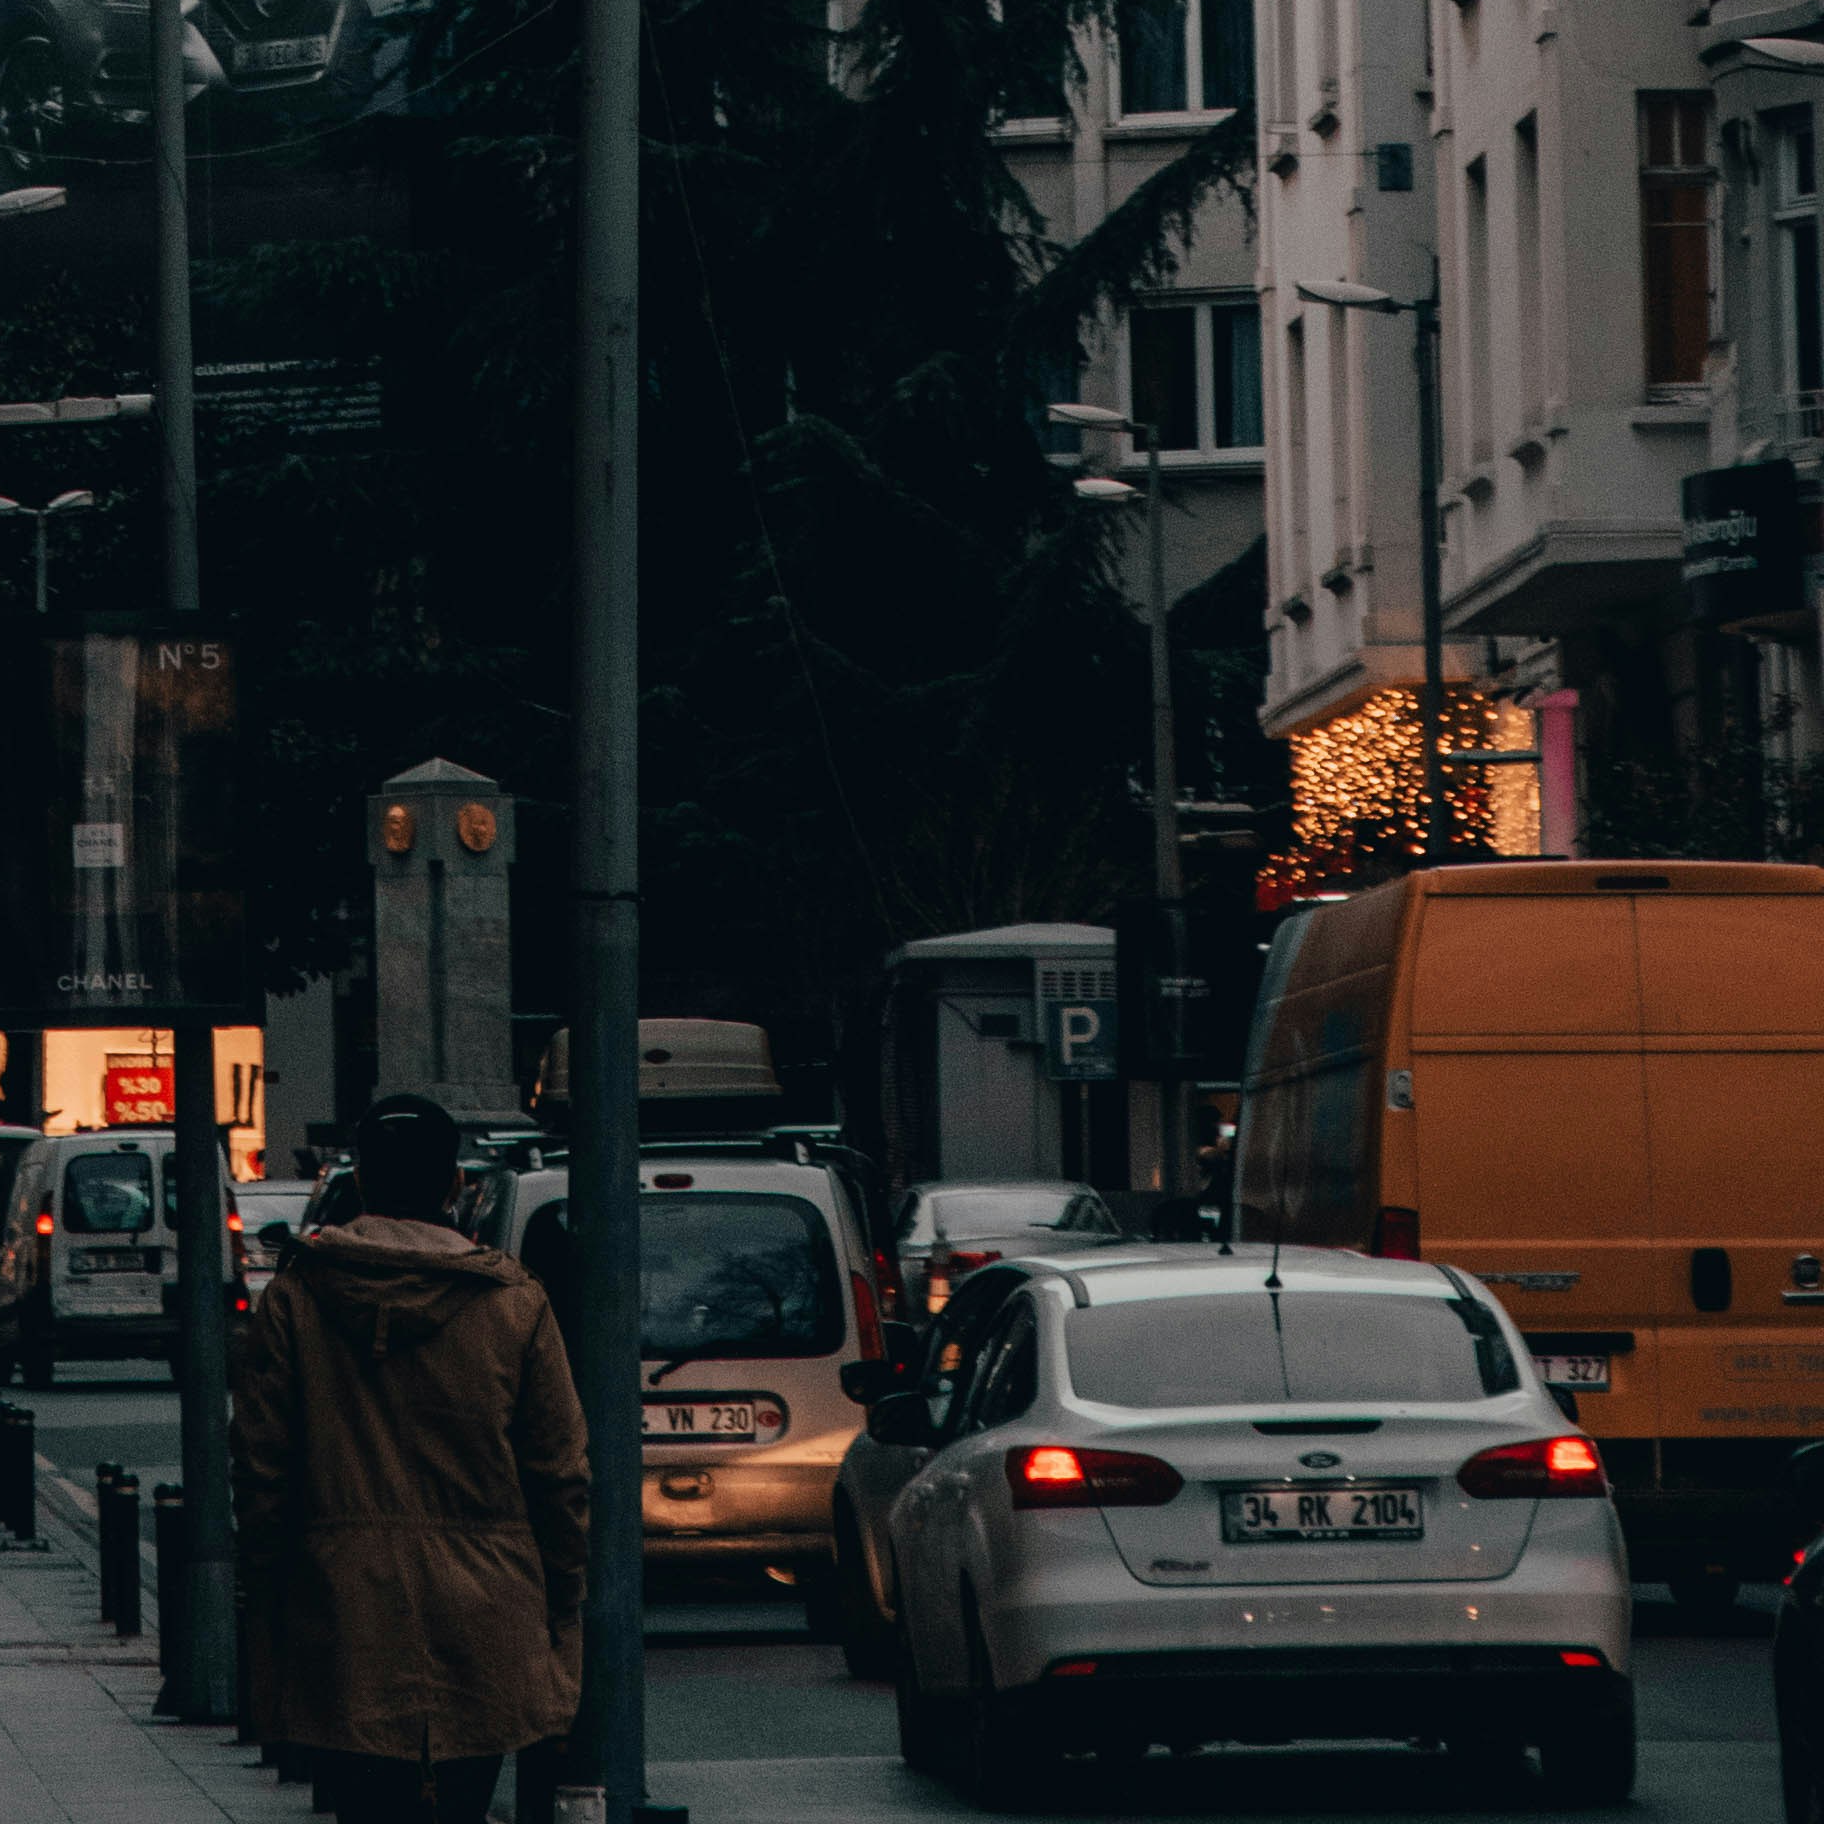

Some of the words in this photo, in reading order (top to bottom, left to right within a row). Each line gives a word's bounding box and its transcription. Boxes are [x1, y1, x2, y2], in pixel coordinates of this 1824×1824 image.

[57, 973, 153, 991] CHANEL
[1061, 1006, 1100, 1065] P
[117, 1076, 162, 1095] %30
[113, 1100, 168, 1121] %50
[1568, 1358, 1606, 1381] 327
[667, 1407, 694, 1430] VN
[710, 1407, 748, 1430] 230
[1246, 1497, 1277, 1527] 34
[1298, 1496, 1333, 1526] RK
[1352, 1495, 1415, 1526] 2104
